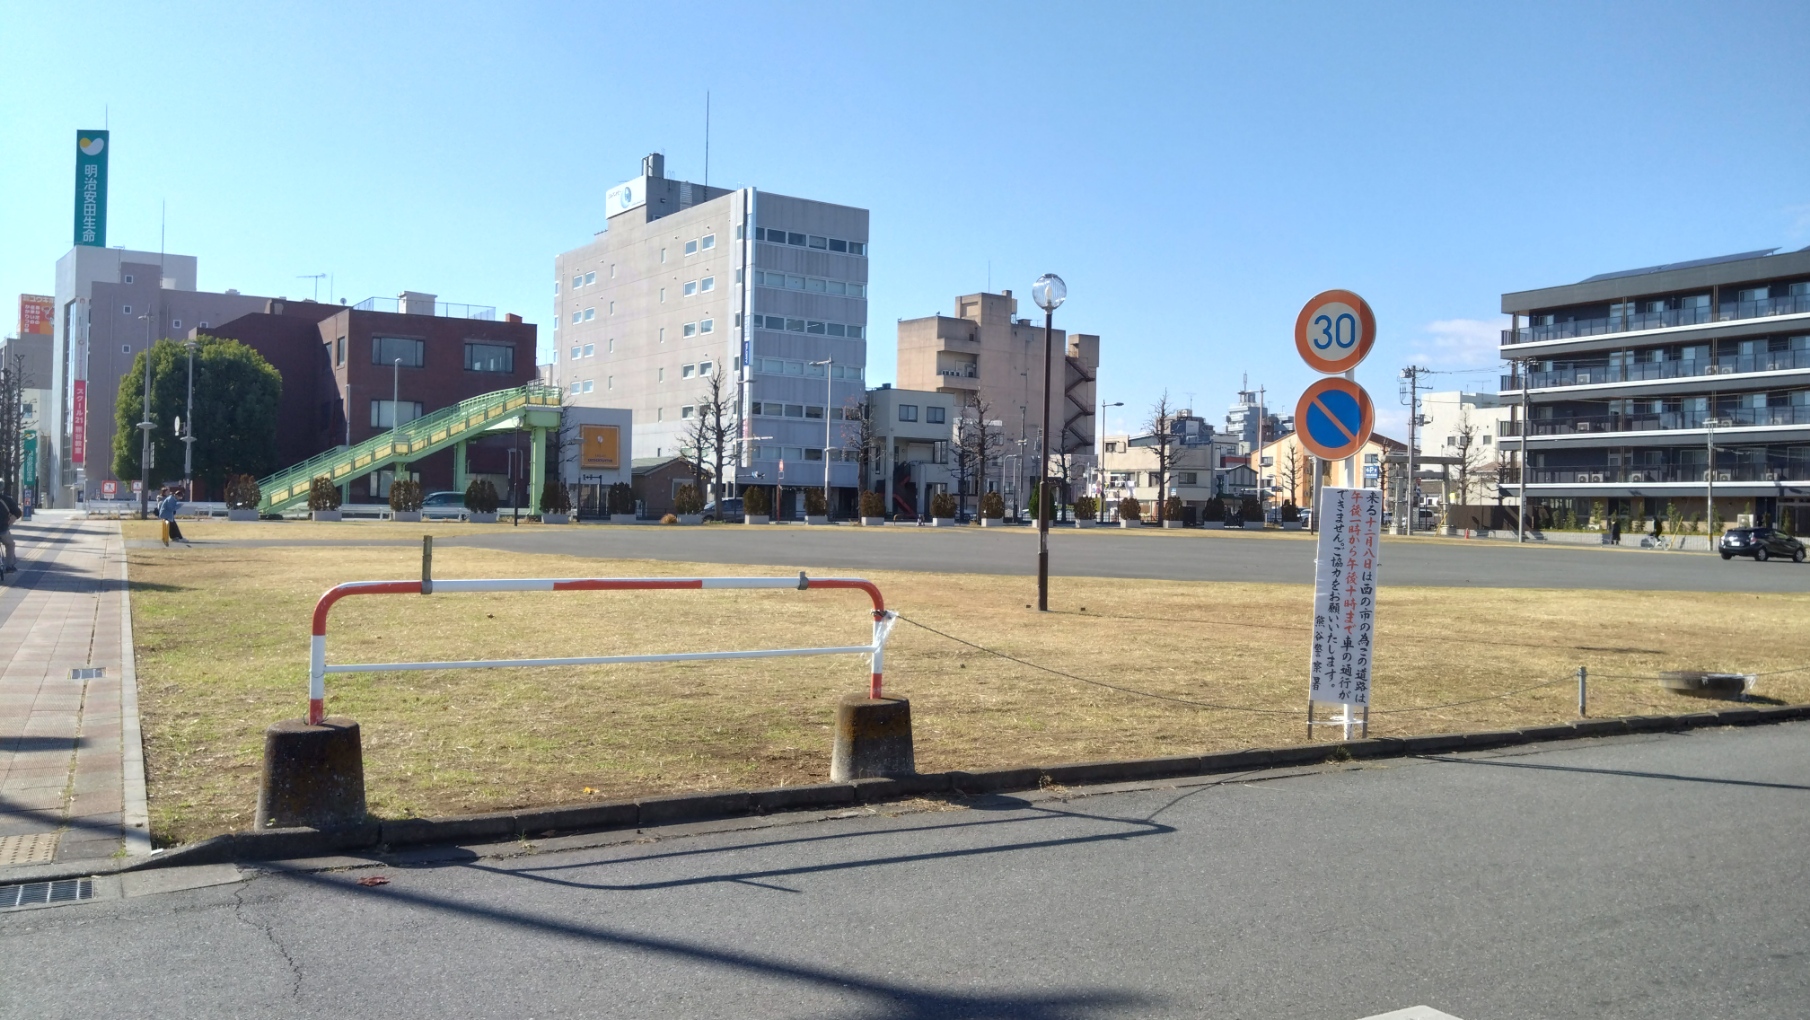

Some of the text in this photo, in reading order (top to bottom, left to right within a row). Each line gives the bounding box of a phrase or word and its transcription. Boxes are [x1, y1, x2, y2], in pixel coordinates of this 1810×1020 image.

[82, 164, 98, 242] 明治安田生命
[1313, 313, 1356, 350] 30
